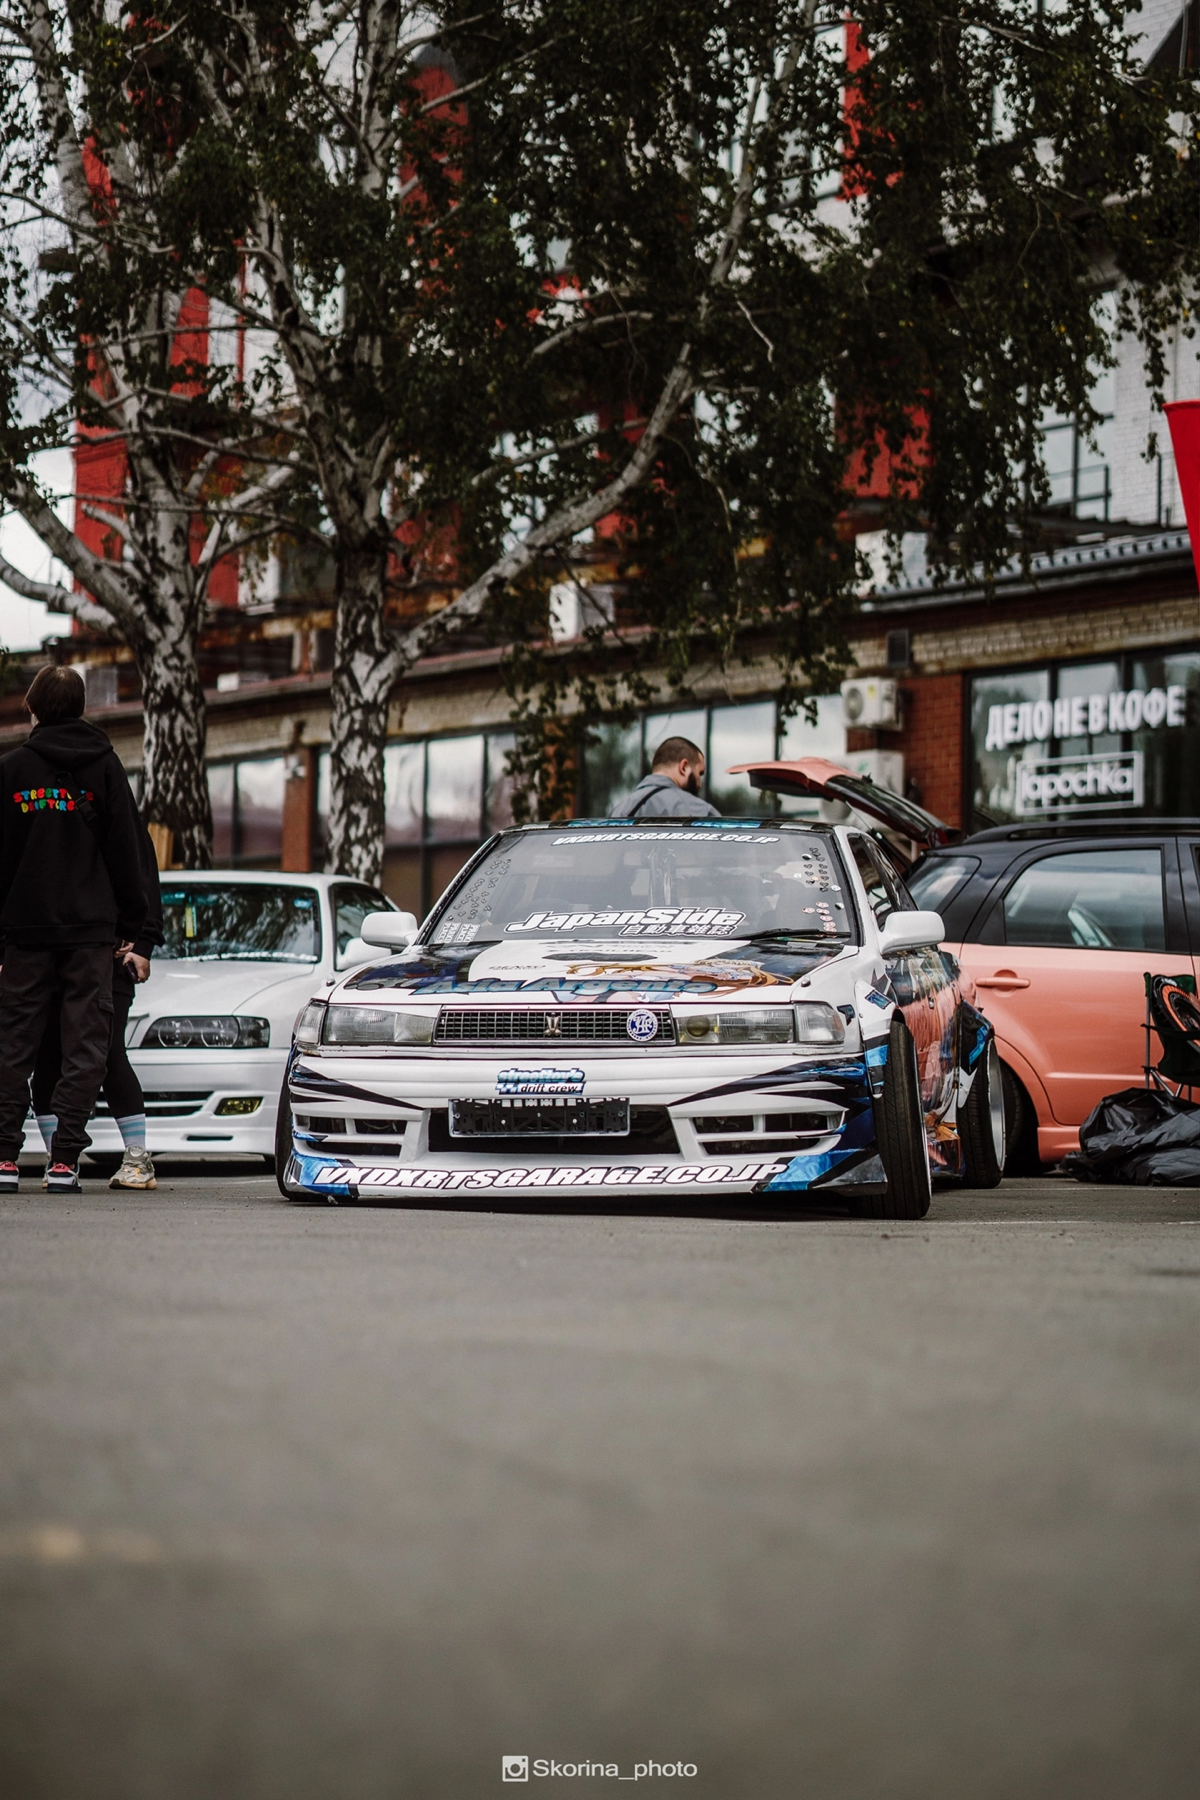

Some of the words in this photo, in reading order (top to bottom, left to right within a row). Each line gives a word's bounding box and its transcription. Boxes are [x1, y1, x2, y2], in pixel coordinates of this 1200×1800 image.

[985, 701, 1052, 751] ДЕЛО
[1054, 698, 1087, 738] НЕ
[1088, 694, 1108, 735] В
[1109, 684, 1185, 732] КОФЕ
[1022, 761, 1134, 807] lapochka
[504, 907, 746, 932] JapanSide
[408, 977, 526, 995] Asia
[520, 977, 718, 996] Argento
[520, 1084, 545, 1093] drift
[548, 1085, 578, 1094] crew
[312, 1162, 788, 1190] VXDXRTSGARAGE.CO.JP
